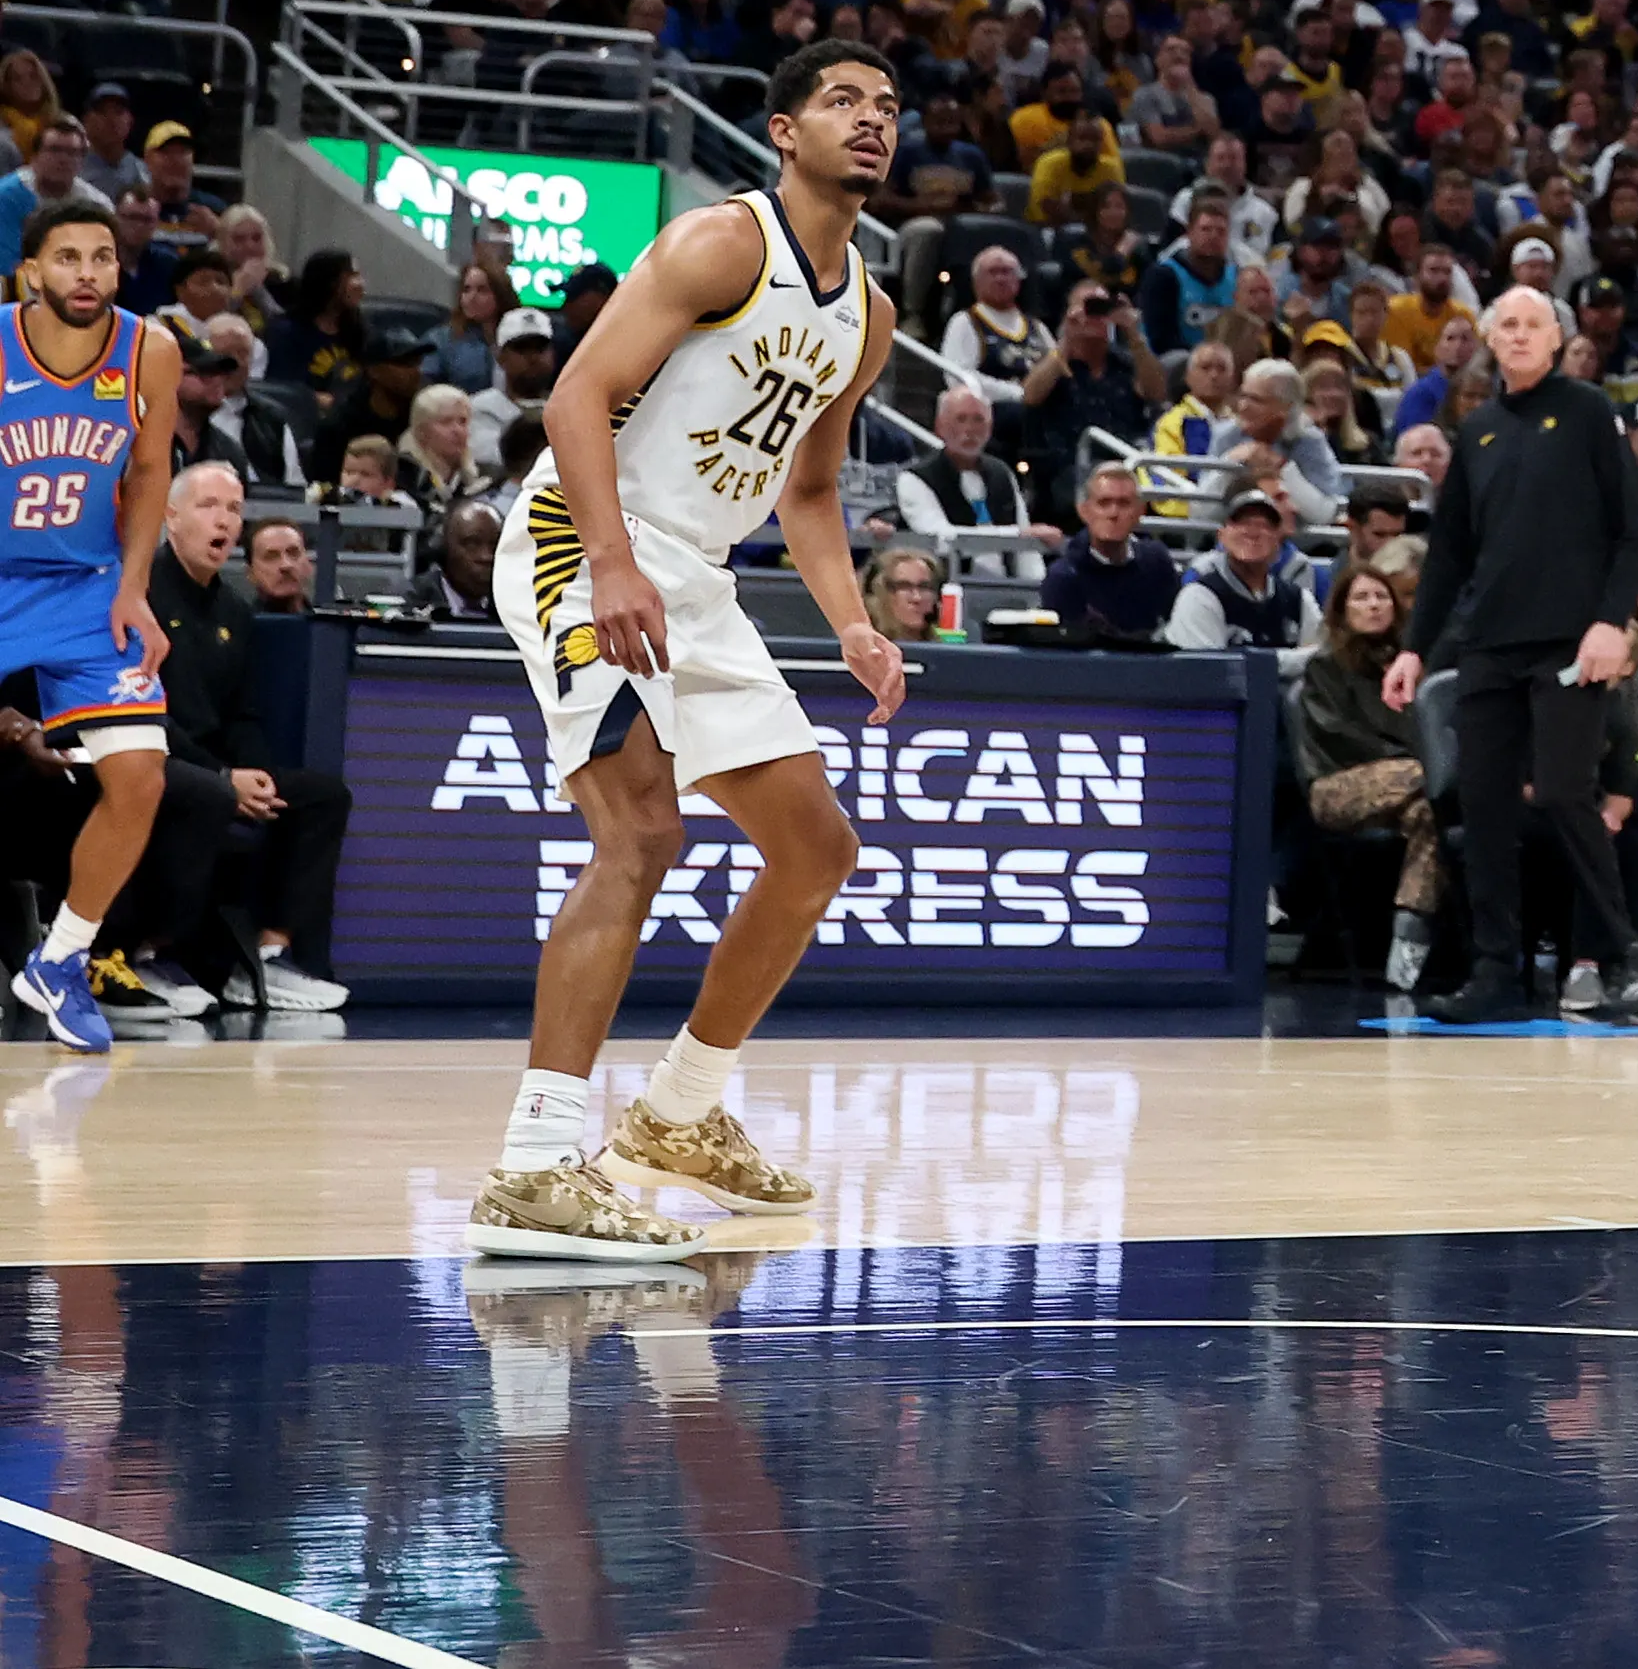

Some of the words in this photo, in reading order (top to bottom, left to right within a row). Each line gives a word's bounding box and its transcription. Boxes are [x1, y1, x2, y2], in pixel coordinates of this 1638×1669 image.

[728, 326, 840, 409] INDIANA
[0, 413, 129, 467] THUNDER
[726, 368, 815, 457] 26
[11, 471, 91, 531] 25
